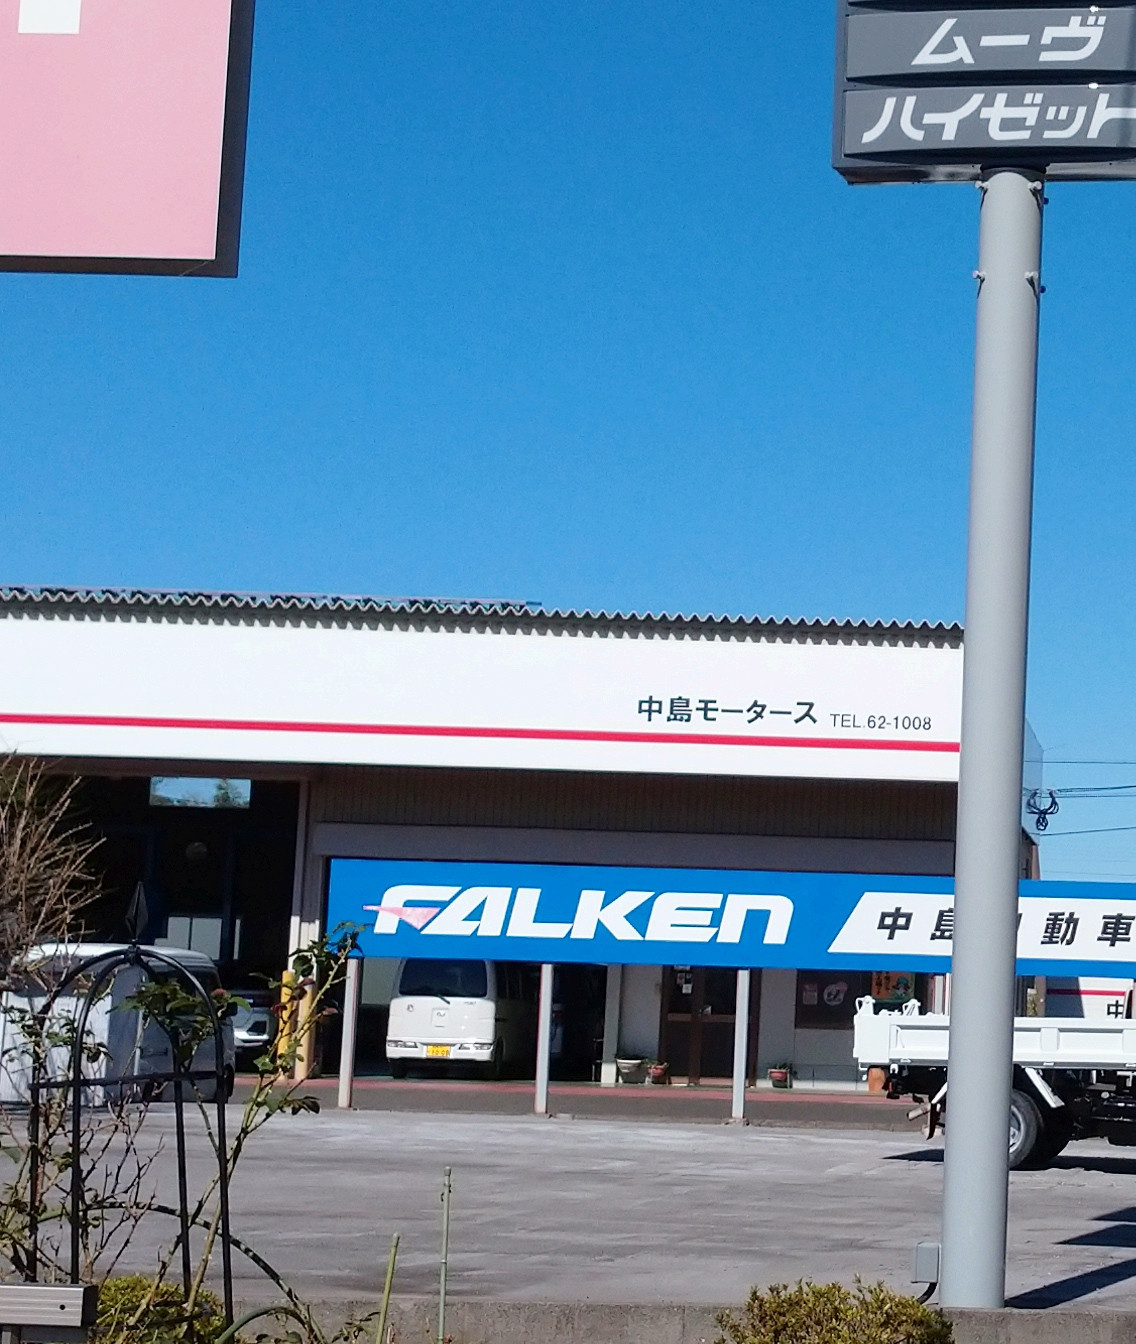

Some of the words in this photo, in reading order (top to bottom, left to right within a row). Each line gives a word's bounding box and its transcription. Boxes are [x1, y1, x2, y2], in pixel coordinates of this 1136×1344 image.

[910, 15, 1107, 66] ムーヴ
[637, 694, 818, 724] 中島モータース
[829, 712, 932, 731] TEL.62-1008
[370, 884, 795, 945] FALKEN
[876, 906, 1136, 948] 中島動車
